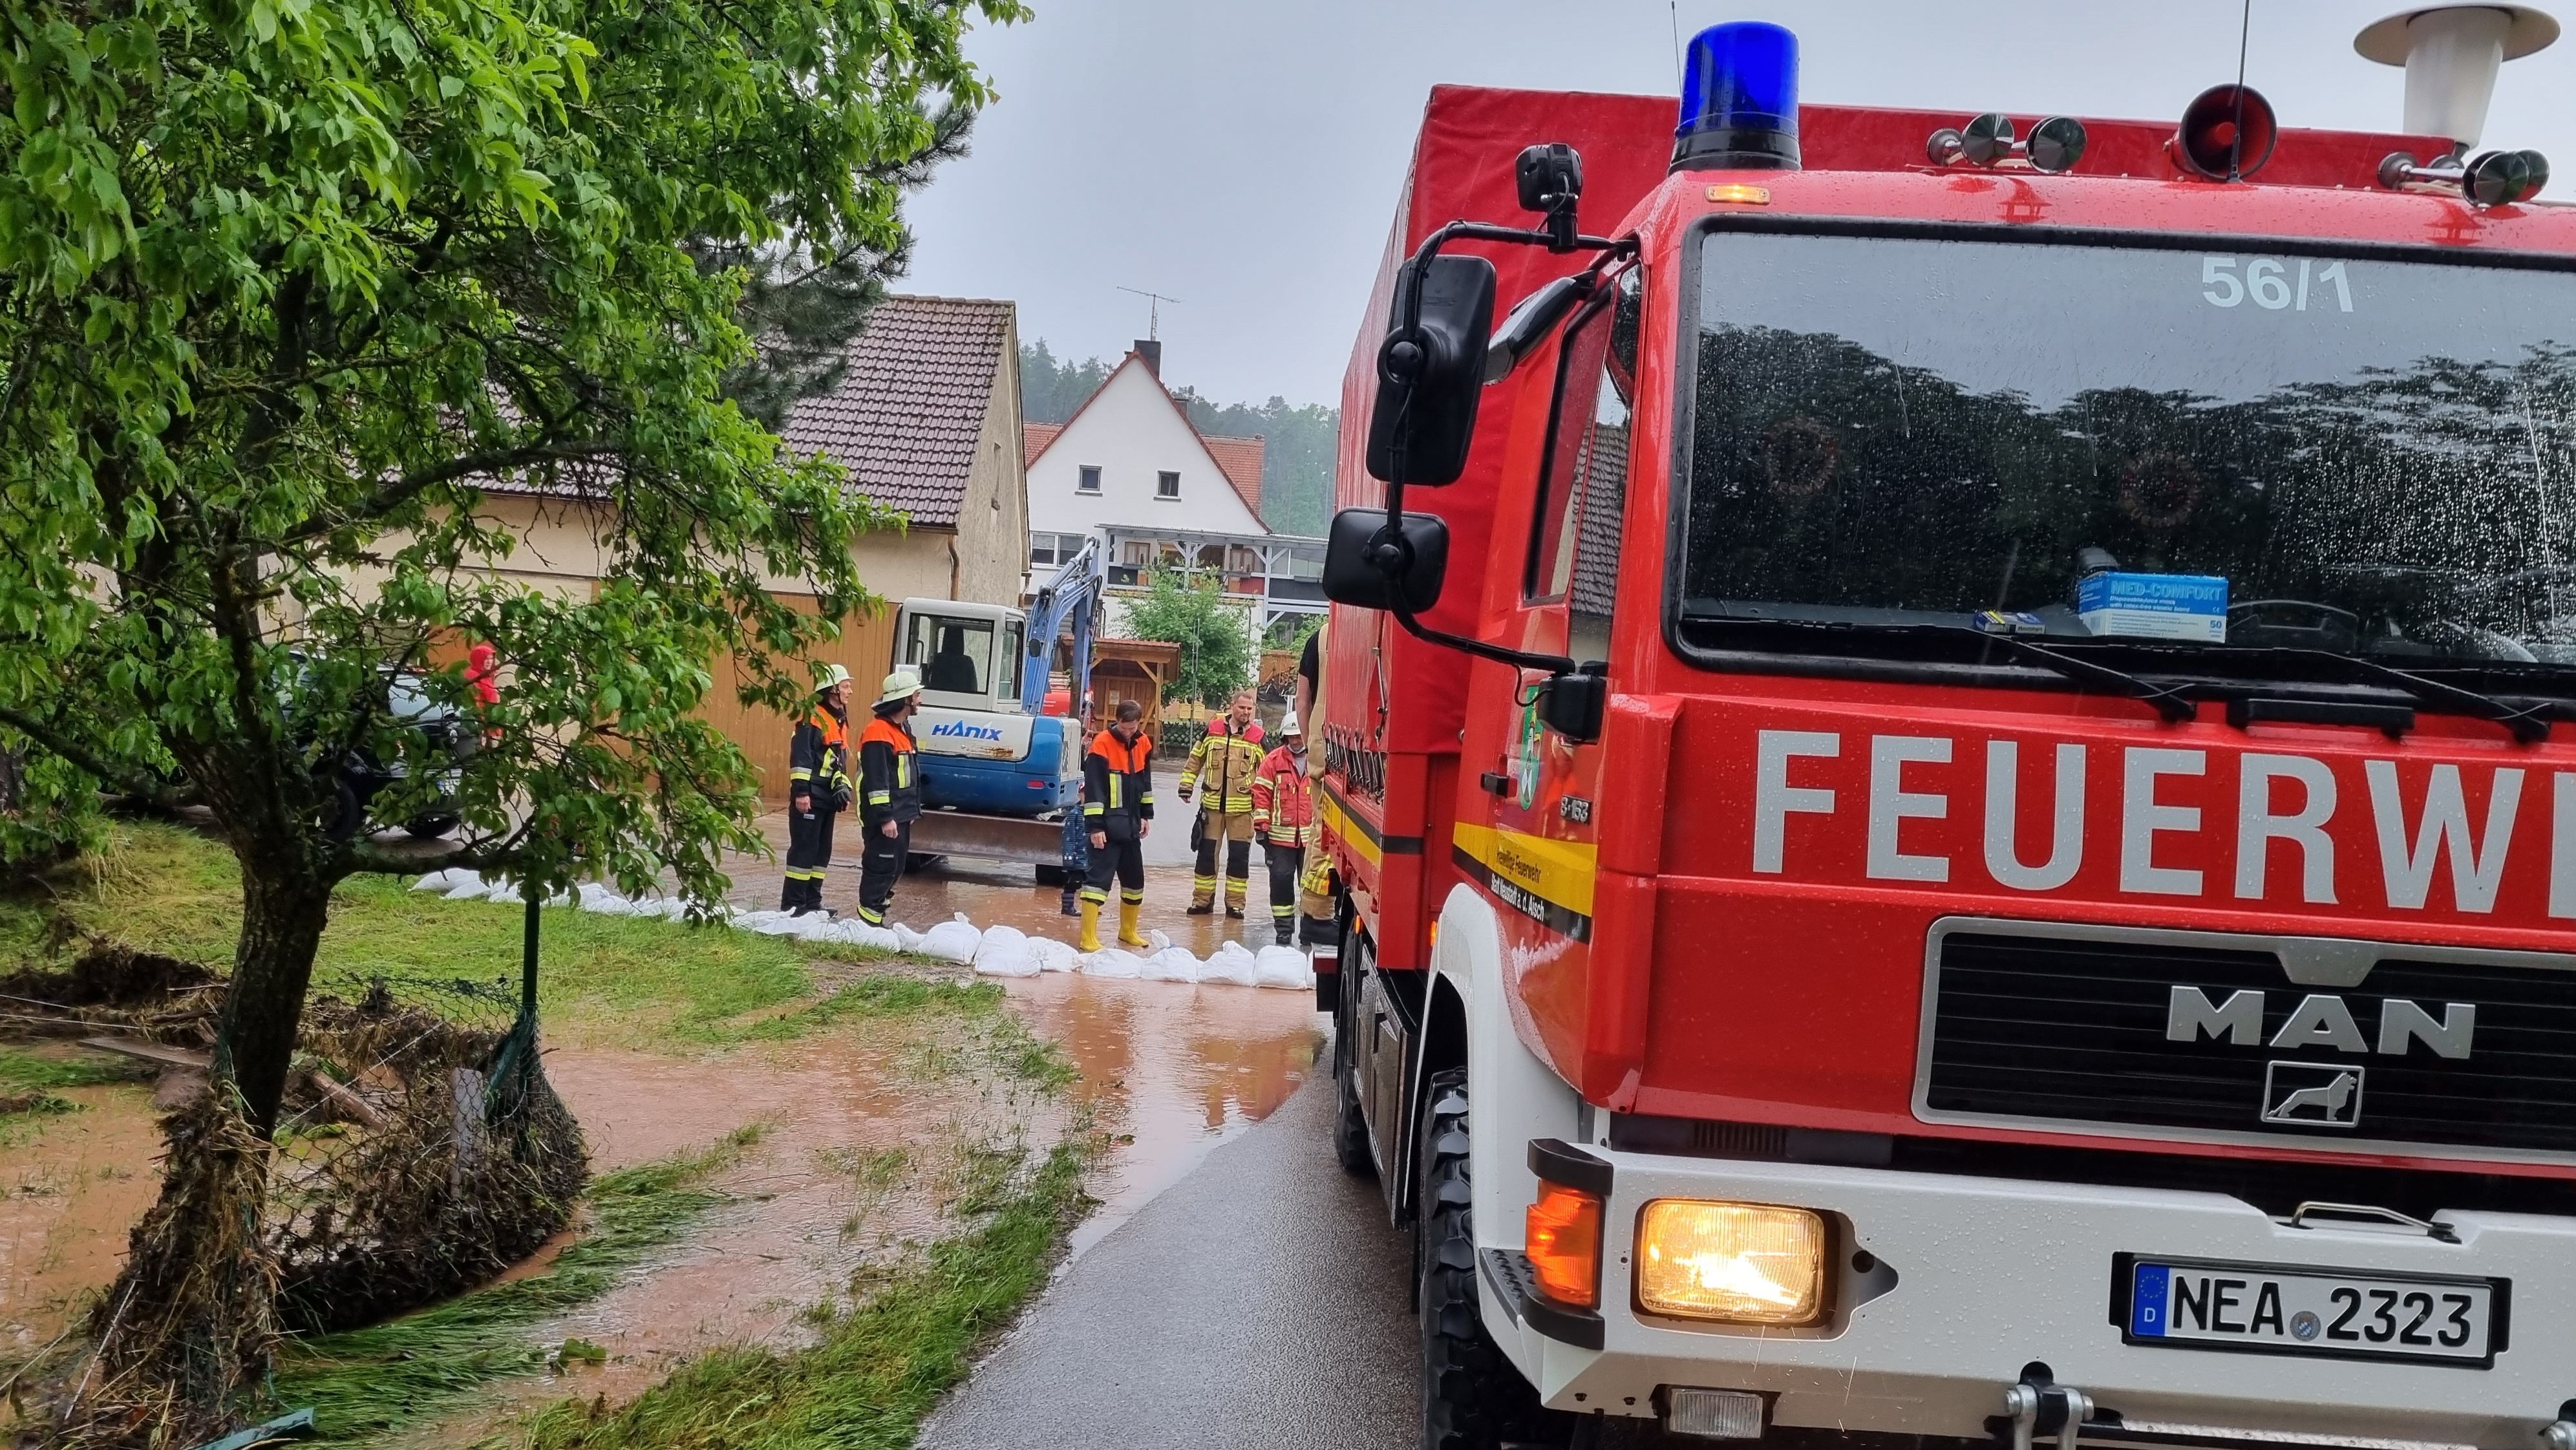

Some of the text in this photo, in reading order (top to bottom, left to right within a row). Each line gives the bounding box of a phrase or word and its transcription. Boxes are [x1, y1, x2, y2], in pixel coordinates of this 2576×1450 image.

[2202, 257, 2354, 312] 56/1
[2110, 581, 2222, 601] MED-COMFORT
[2209, 620, 2222, 629] 50
[1491, 873, 1500, 895] Stadt
[1500, 879, 1518, 906] Neustadt
[1522, 892, 1528, 912] d.
[1528, 895, 1544, 922] Aisch
[2166, 985, 2476, 1060] MAN
[2144, 1307, 2155, 1323] D
[2173, 1275, 2473, 1347] NEA 2323
